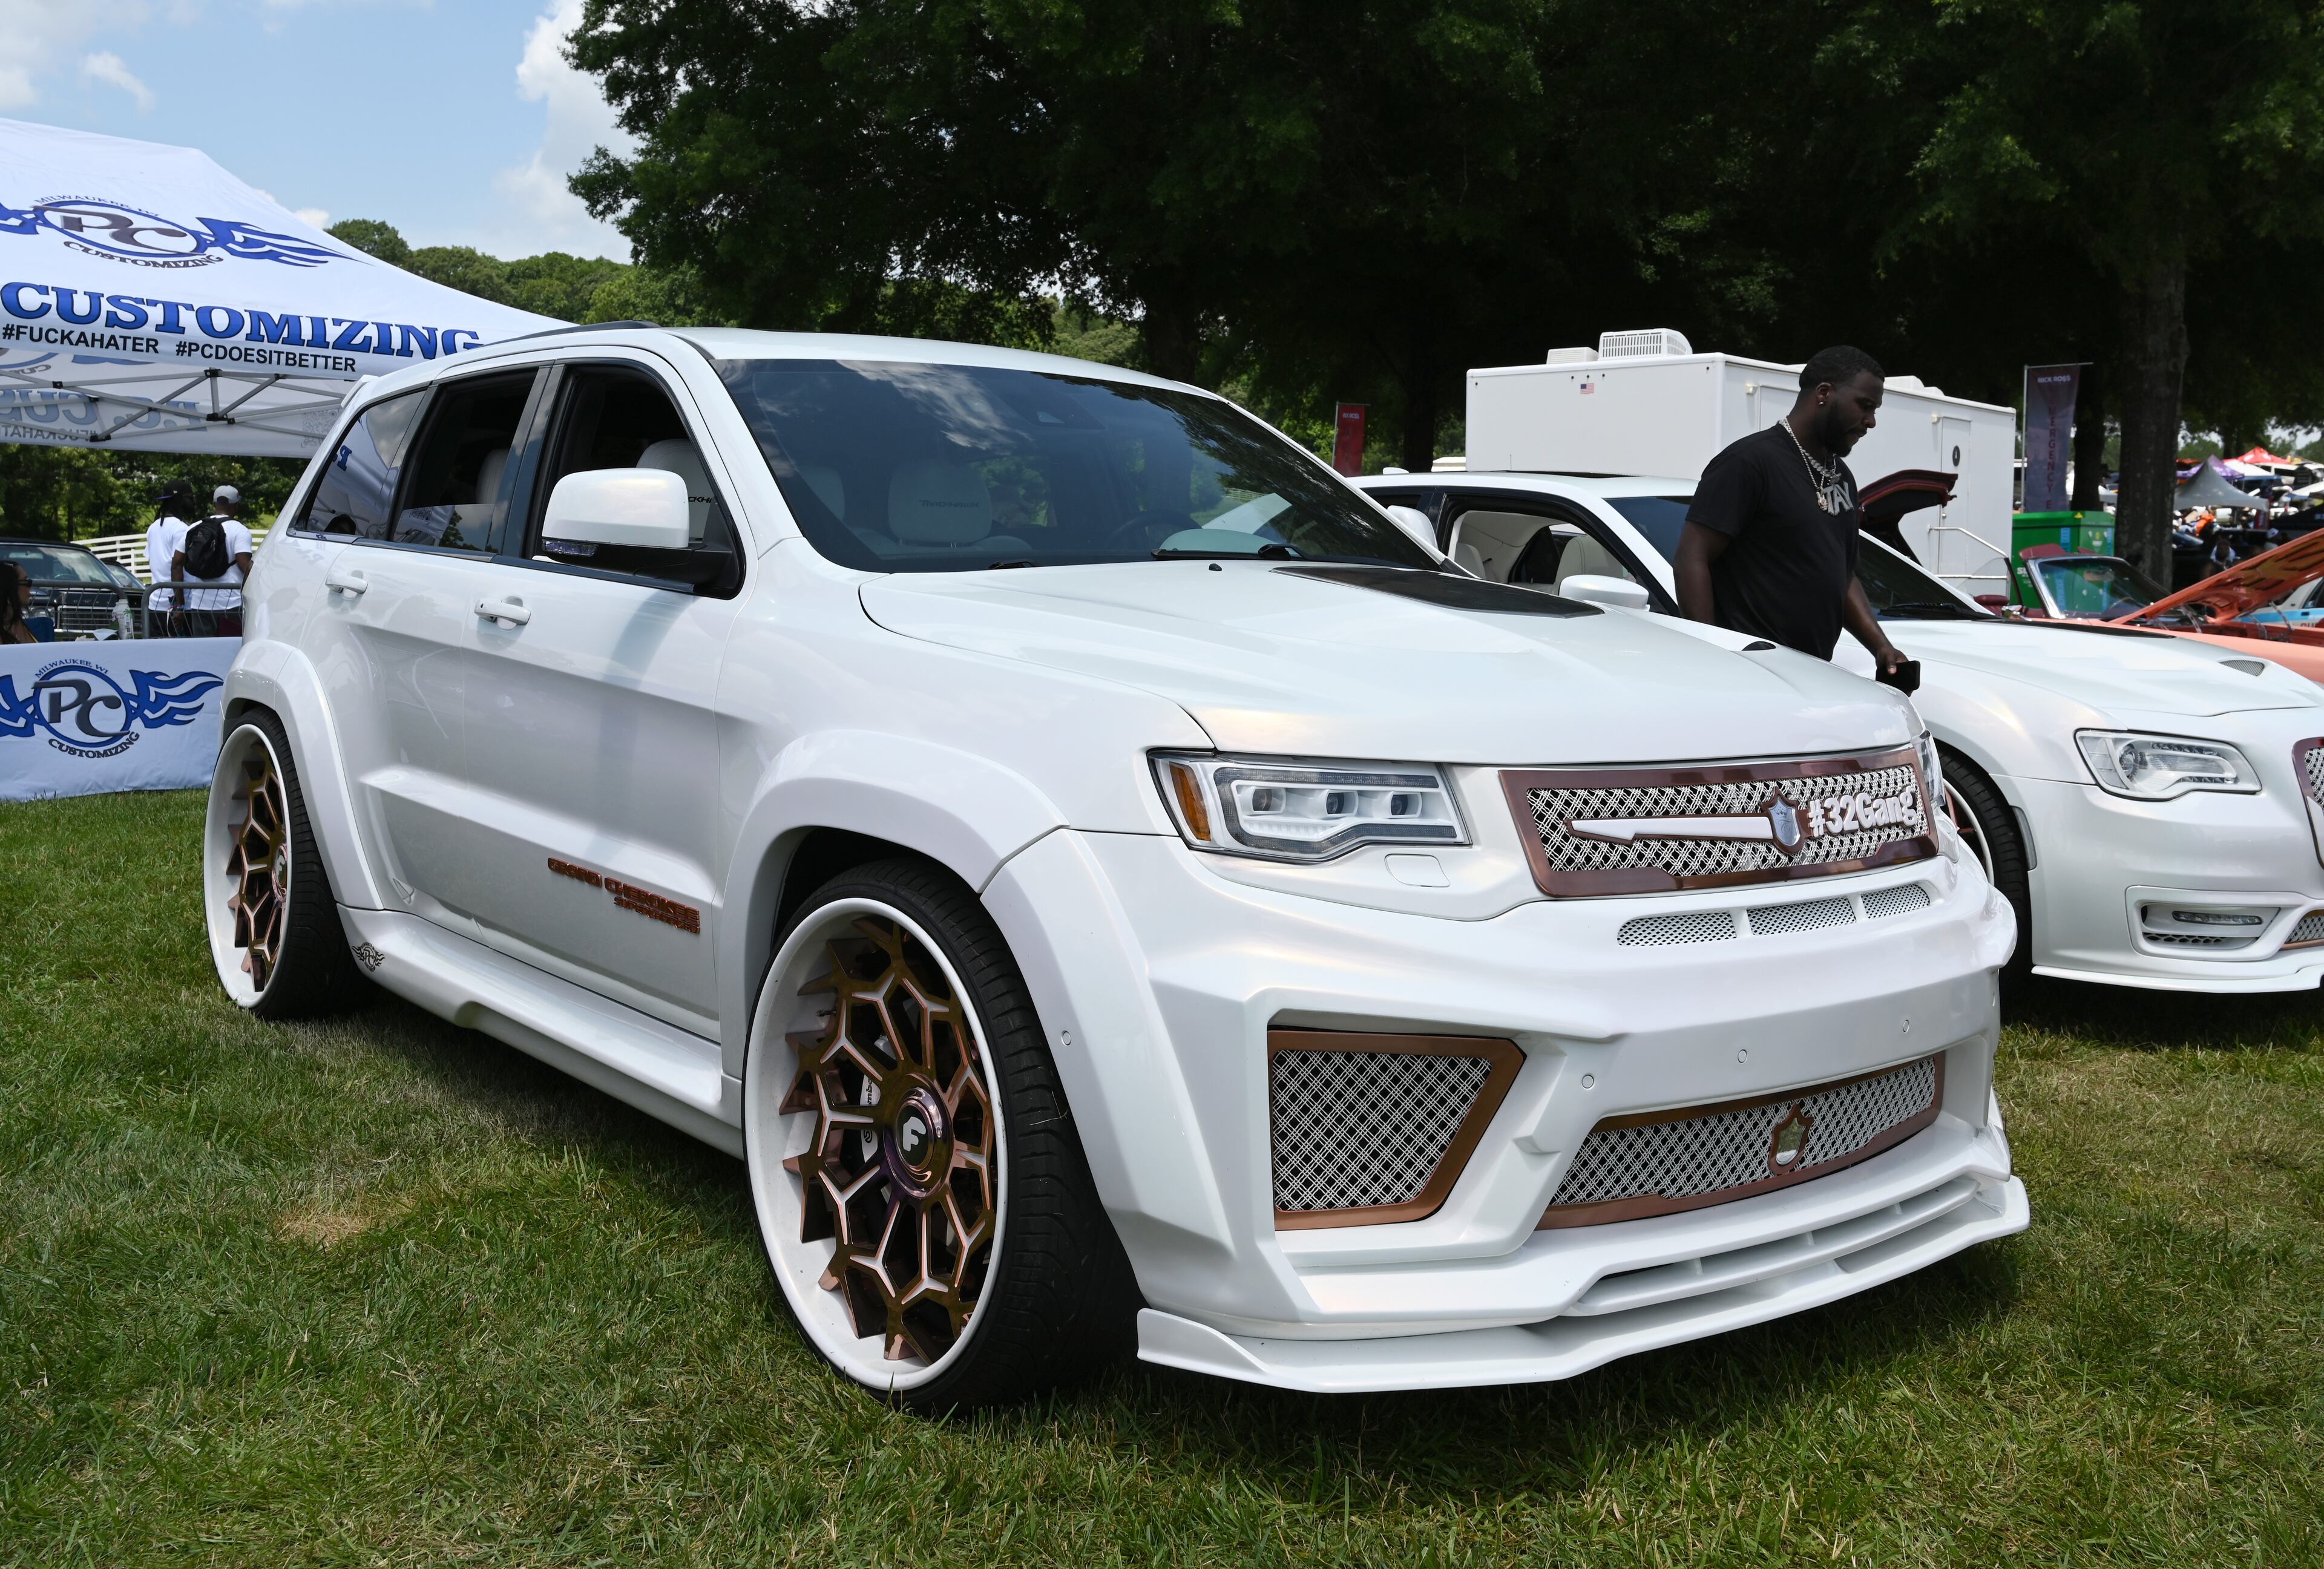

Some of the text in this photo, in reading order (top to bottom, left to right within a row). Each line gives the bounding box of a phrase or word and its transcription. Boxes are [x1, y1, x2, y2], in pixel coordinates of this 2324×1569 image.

[63, 241, 224, 269] CUSTOMIZING
[0, 281, 484, 360] CUSTOMIZING
[2, 323, 356, 373] #FUCKAHATER #PCDOESITBETTER
[2037, 375, 2052, 384] RICK
[31, 679, 131, 737] PC
[48, 730, 140, 758] CUSTOMIZING
[1808, 786, 1917, 837] #32Gang
